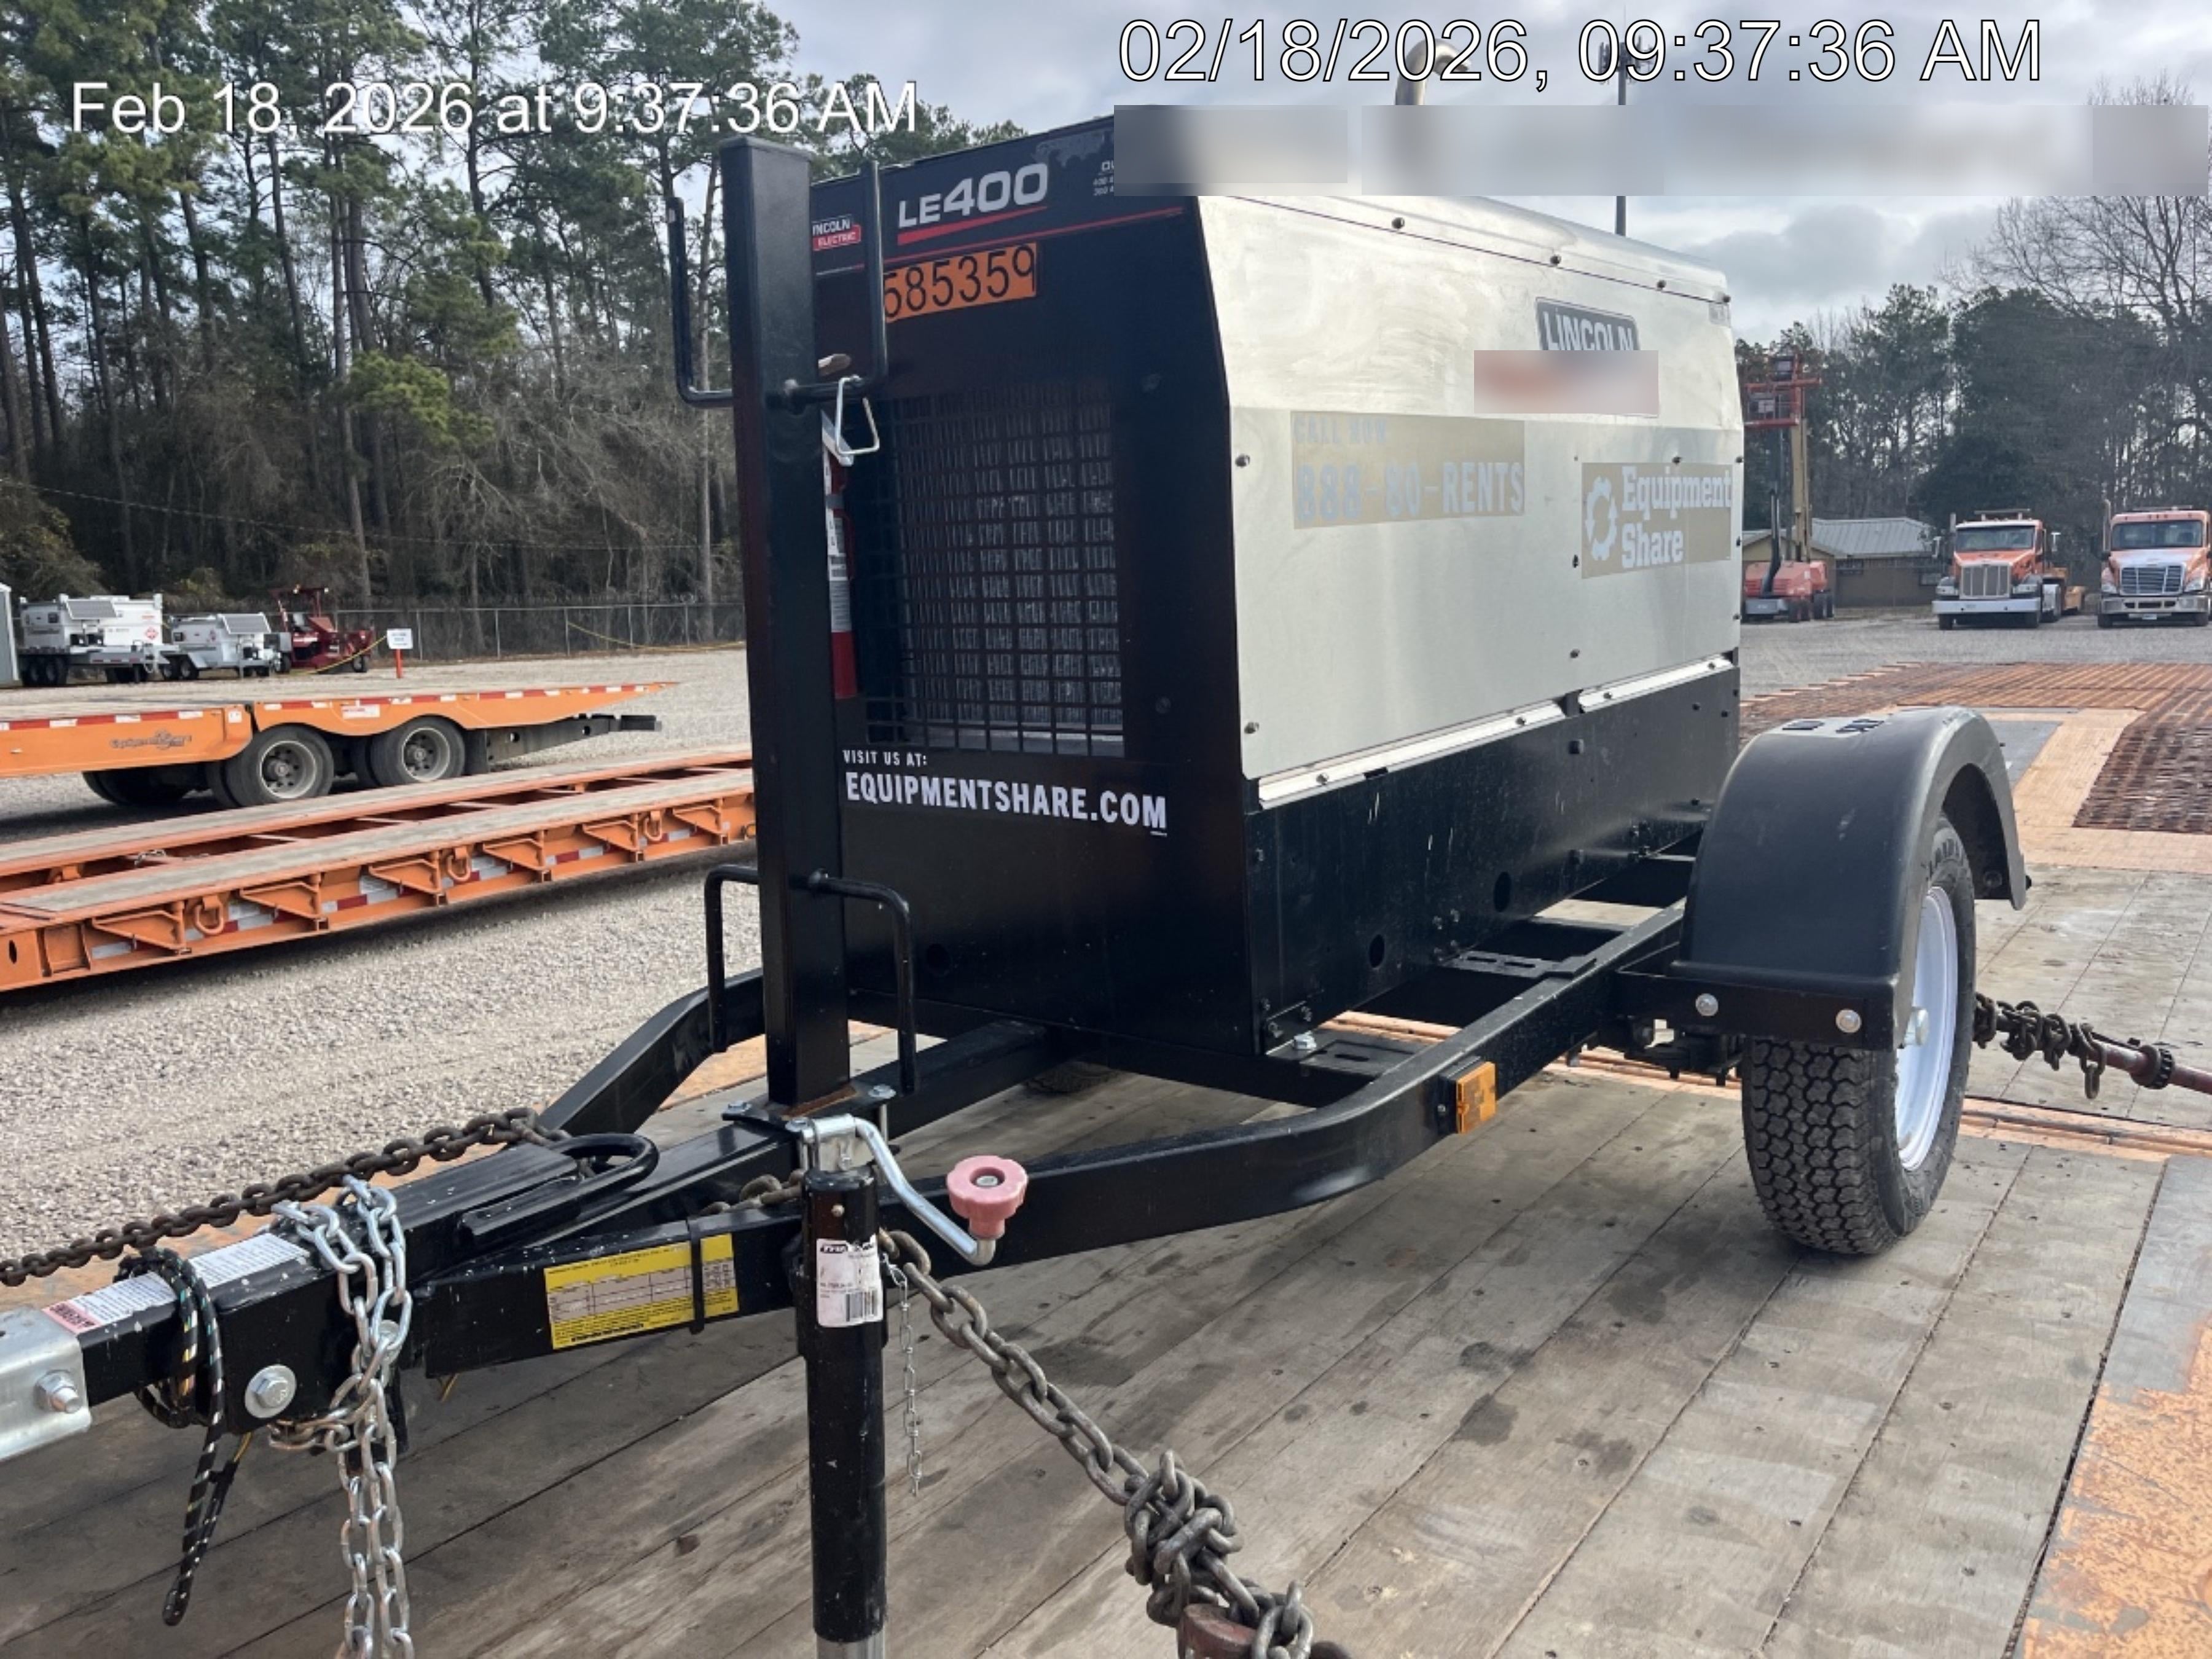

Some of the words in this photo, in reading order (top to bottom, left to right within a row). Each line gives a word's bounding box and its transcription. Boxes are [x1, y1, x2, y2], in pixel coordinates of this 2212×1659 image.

[898, 163, 1048, 229] LE400
[812, 219, 851, 235] INCOLN
[1622, 465, 1733, 520] Equipment
[1622, 522, 1684, 568] Share
[842, 750, 878, 764] VISIT
[883, 751, 900, 766] US
[906, 752, 927, 767] AT:
[845, 771, 1166, 829] EQUIPMENTSHARE.COM
